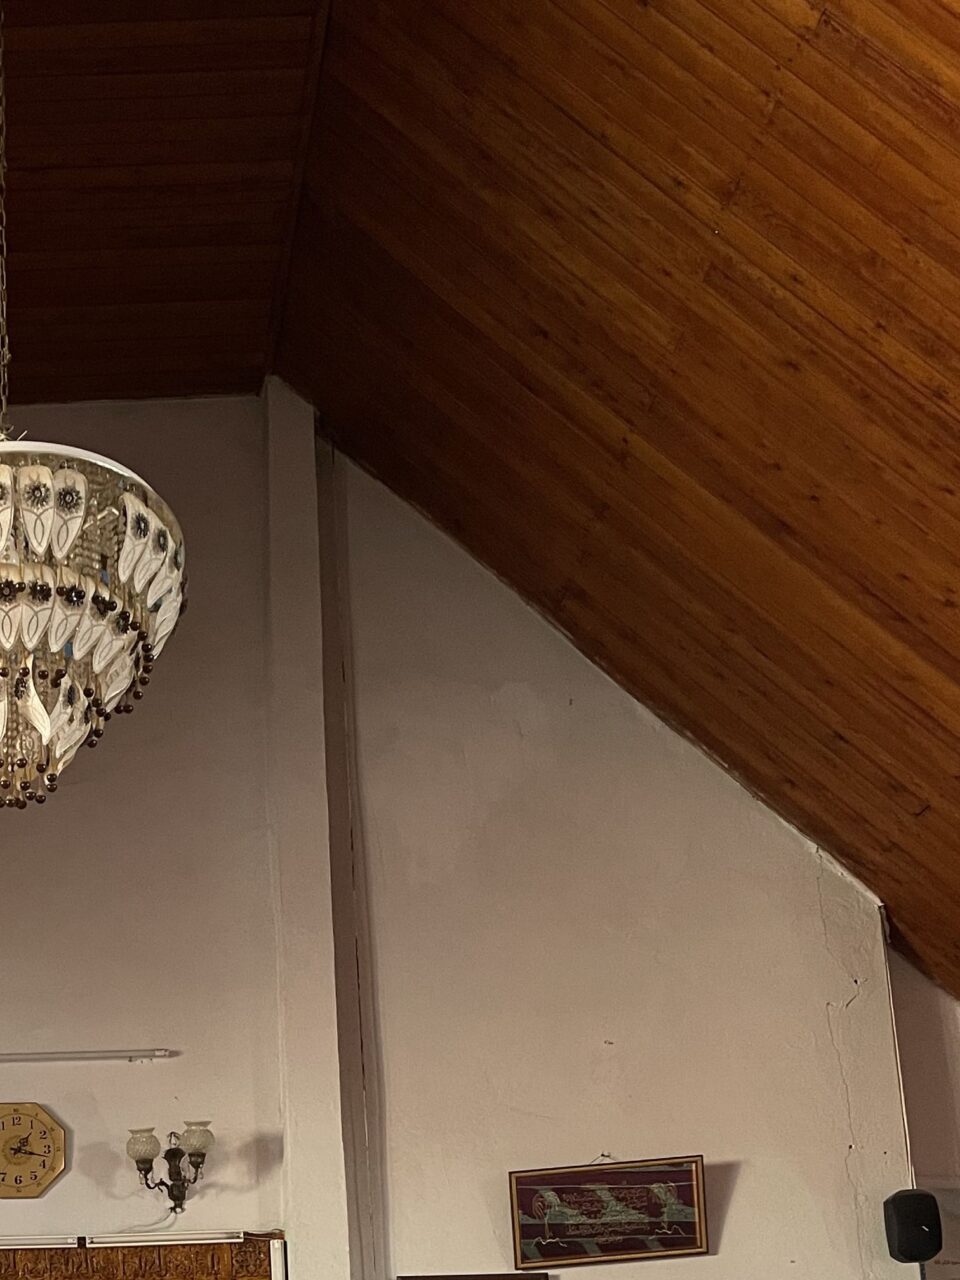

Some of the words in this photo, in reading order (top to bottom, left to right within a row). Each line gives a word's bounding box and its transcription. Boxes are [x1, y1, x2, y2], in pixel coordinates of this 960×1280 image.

[11, 1116, 22, 1127] 12
[29, 1120, 34, 1130] 1
[39, 1130, 48, 1140] 2
[43, 1144, 52, 1155] 3
[0, 1172, 8, 1182] 7
[14, 1175, 23, 1185] 6
[30, 1171, 38, 1181] 5
